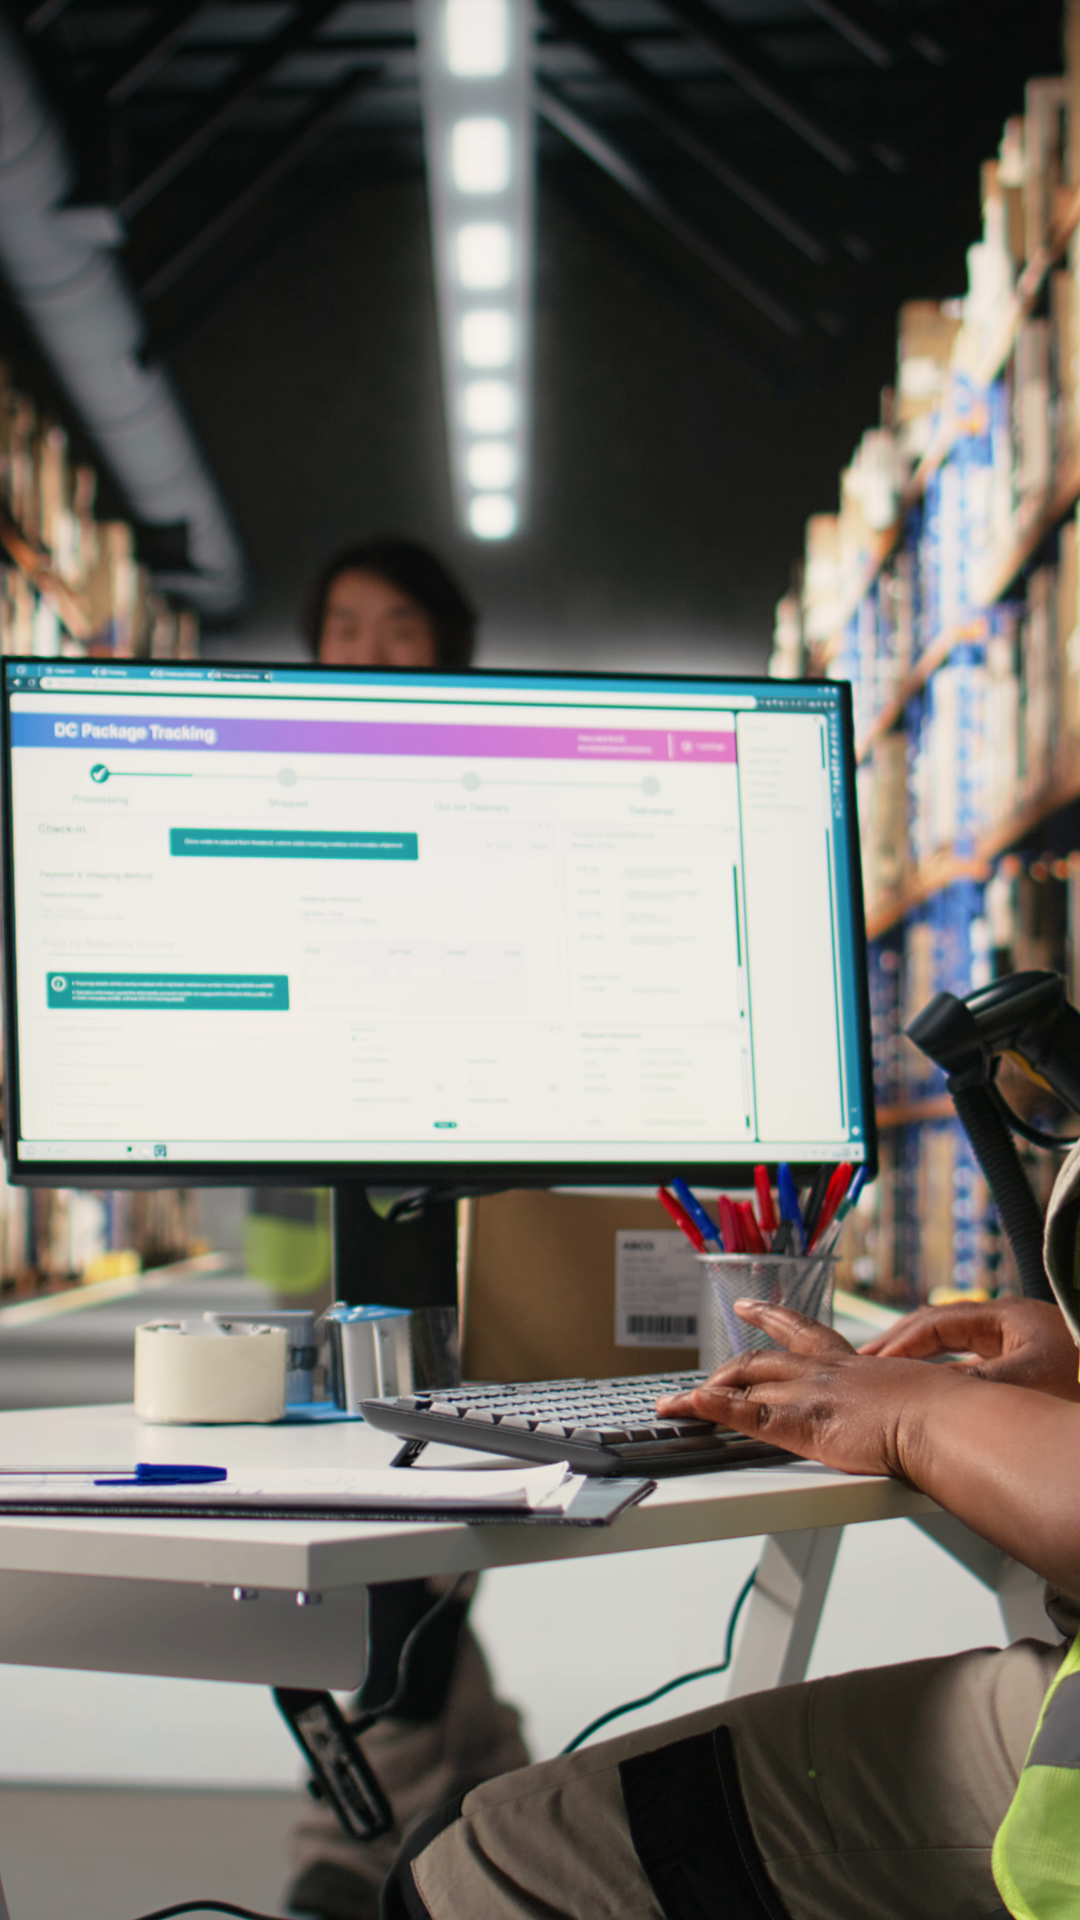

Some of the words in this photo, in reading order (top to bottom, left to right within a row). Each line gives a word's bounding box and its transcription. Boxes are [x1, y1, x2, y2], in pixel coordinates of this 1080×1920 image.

[54, 722, 78, 739] DC
[81, 722, 148, 743] Package
[149, 724, 217, 745] Tracking
[72, 794, 129, 807] Processing
[38, 823, 87, 834] Check-in
